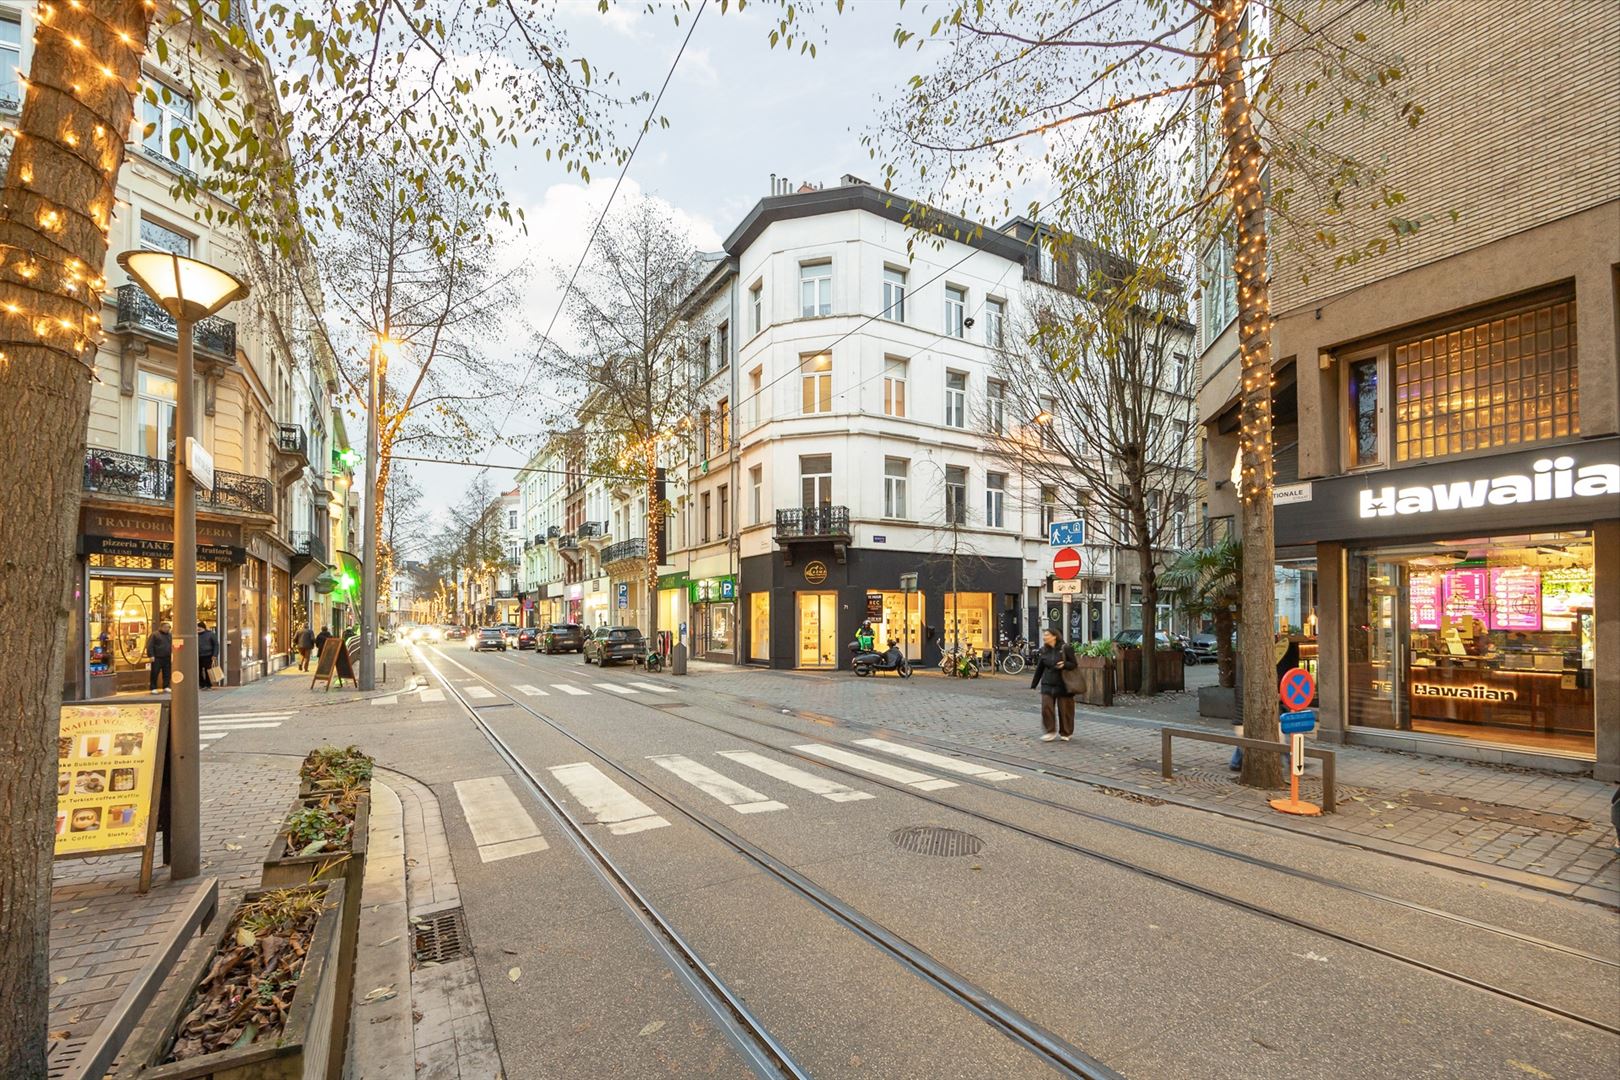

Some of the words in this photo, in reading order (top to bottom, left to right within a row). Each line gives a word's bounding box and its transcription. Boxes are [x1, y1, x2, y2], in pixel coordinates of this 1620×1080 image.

[1273, 490, 1303, 498] TIONALE
[96, 516, 174, 532] TRATTORIA
[199, 526, 233, 538] ZERIA
[102, 539, 137, 549] pizzeria
[139, 541, 169, 550] TAKE
[619, 585, 627, 594] P
[723, 583, 732, 595] P
[1414, 684, 1517, 701] Hawaiian
